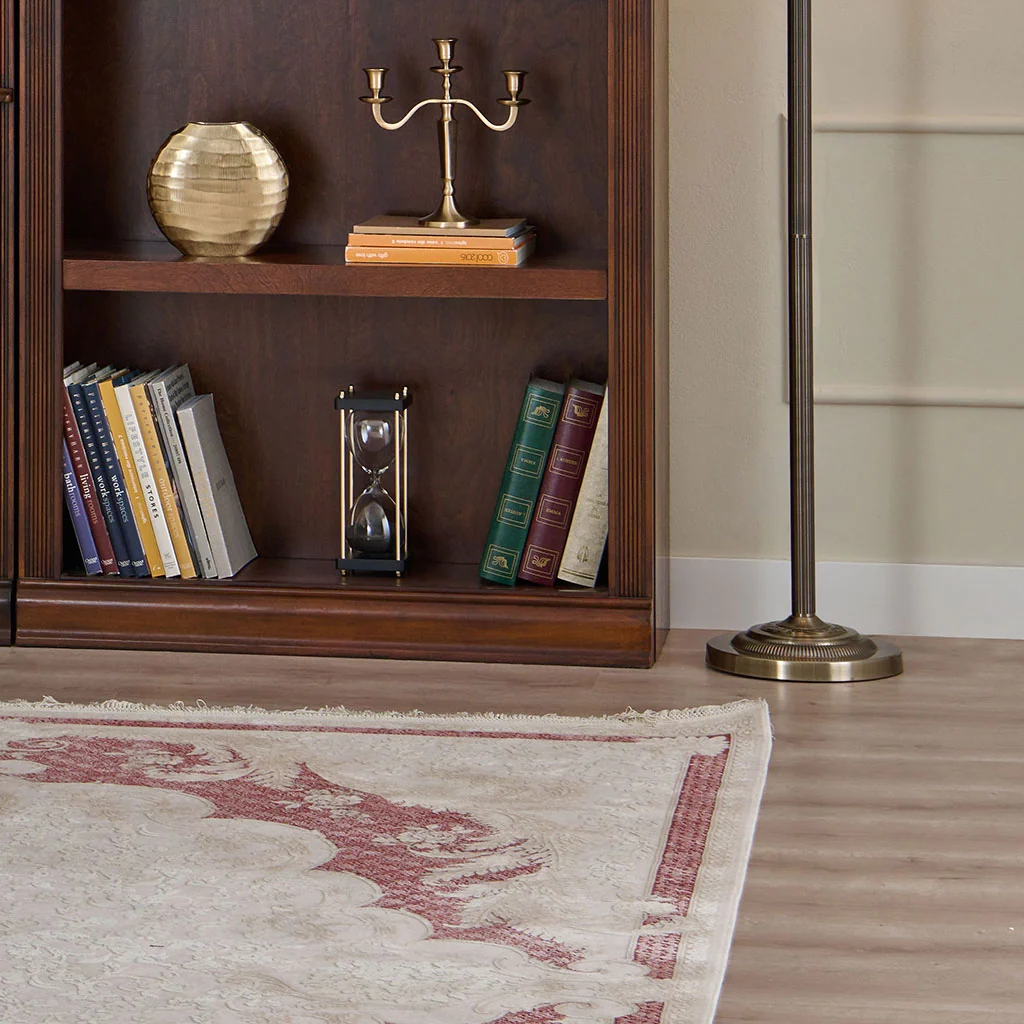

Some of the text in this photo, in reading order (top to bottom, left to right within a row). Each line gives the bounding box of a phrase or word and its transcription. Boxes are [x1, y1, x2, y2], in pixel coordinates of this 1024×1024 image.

[158, 396, 168, 412] Home
[162, 411, 176, 437] Collection
[123, 412, 160, 520] LIFESTYLE STORES
[61, 471, 83, 518] bathrooms
[77, 472, 95, 500] living
[156, 476, 175, 513] outdoor
